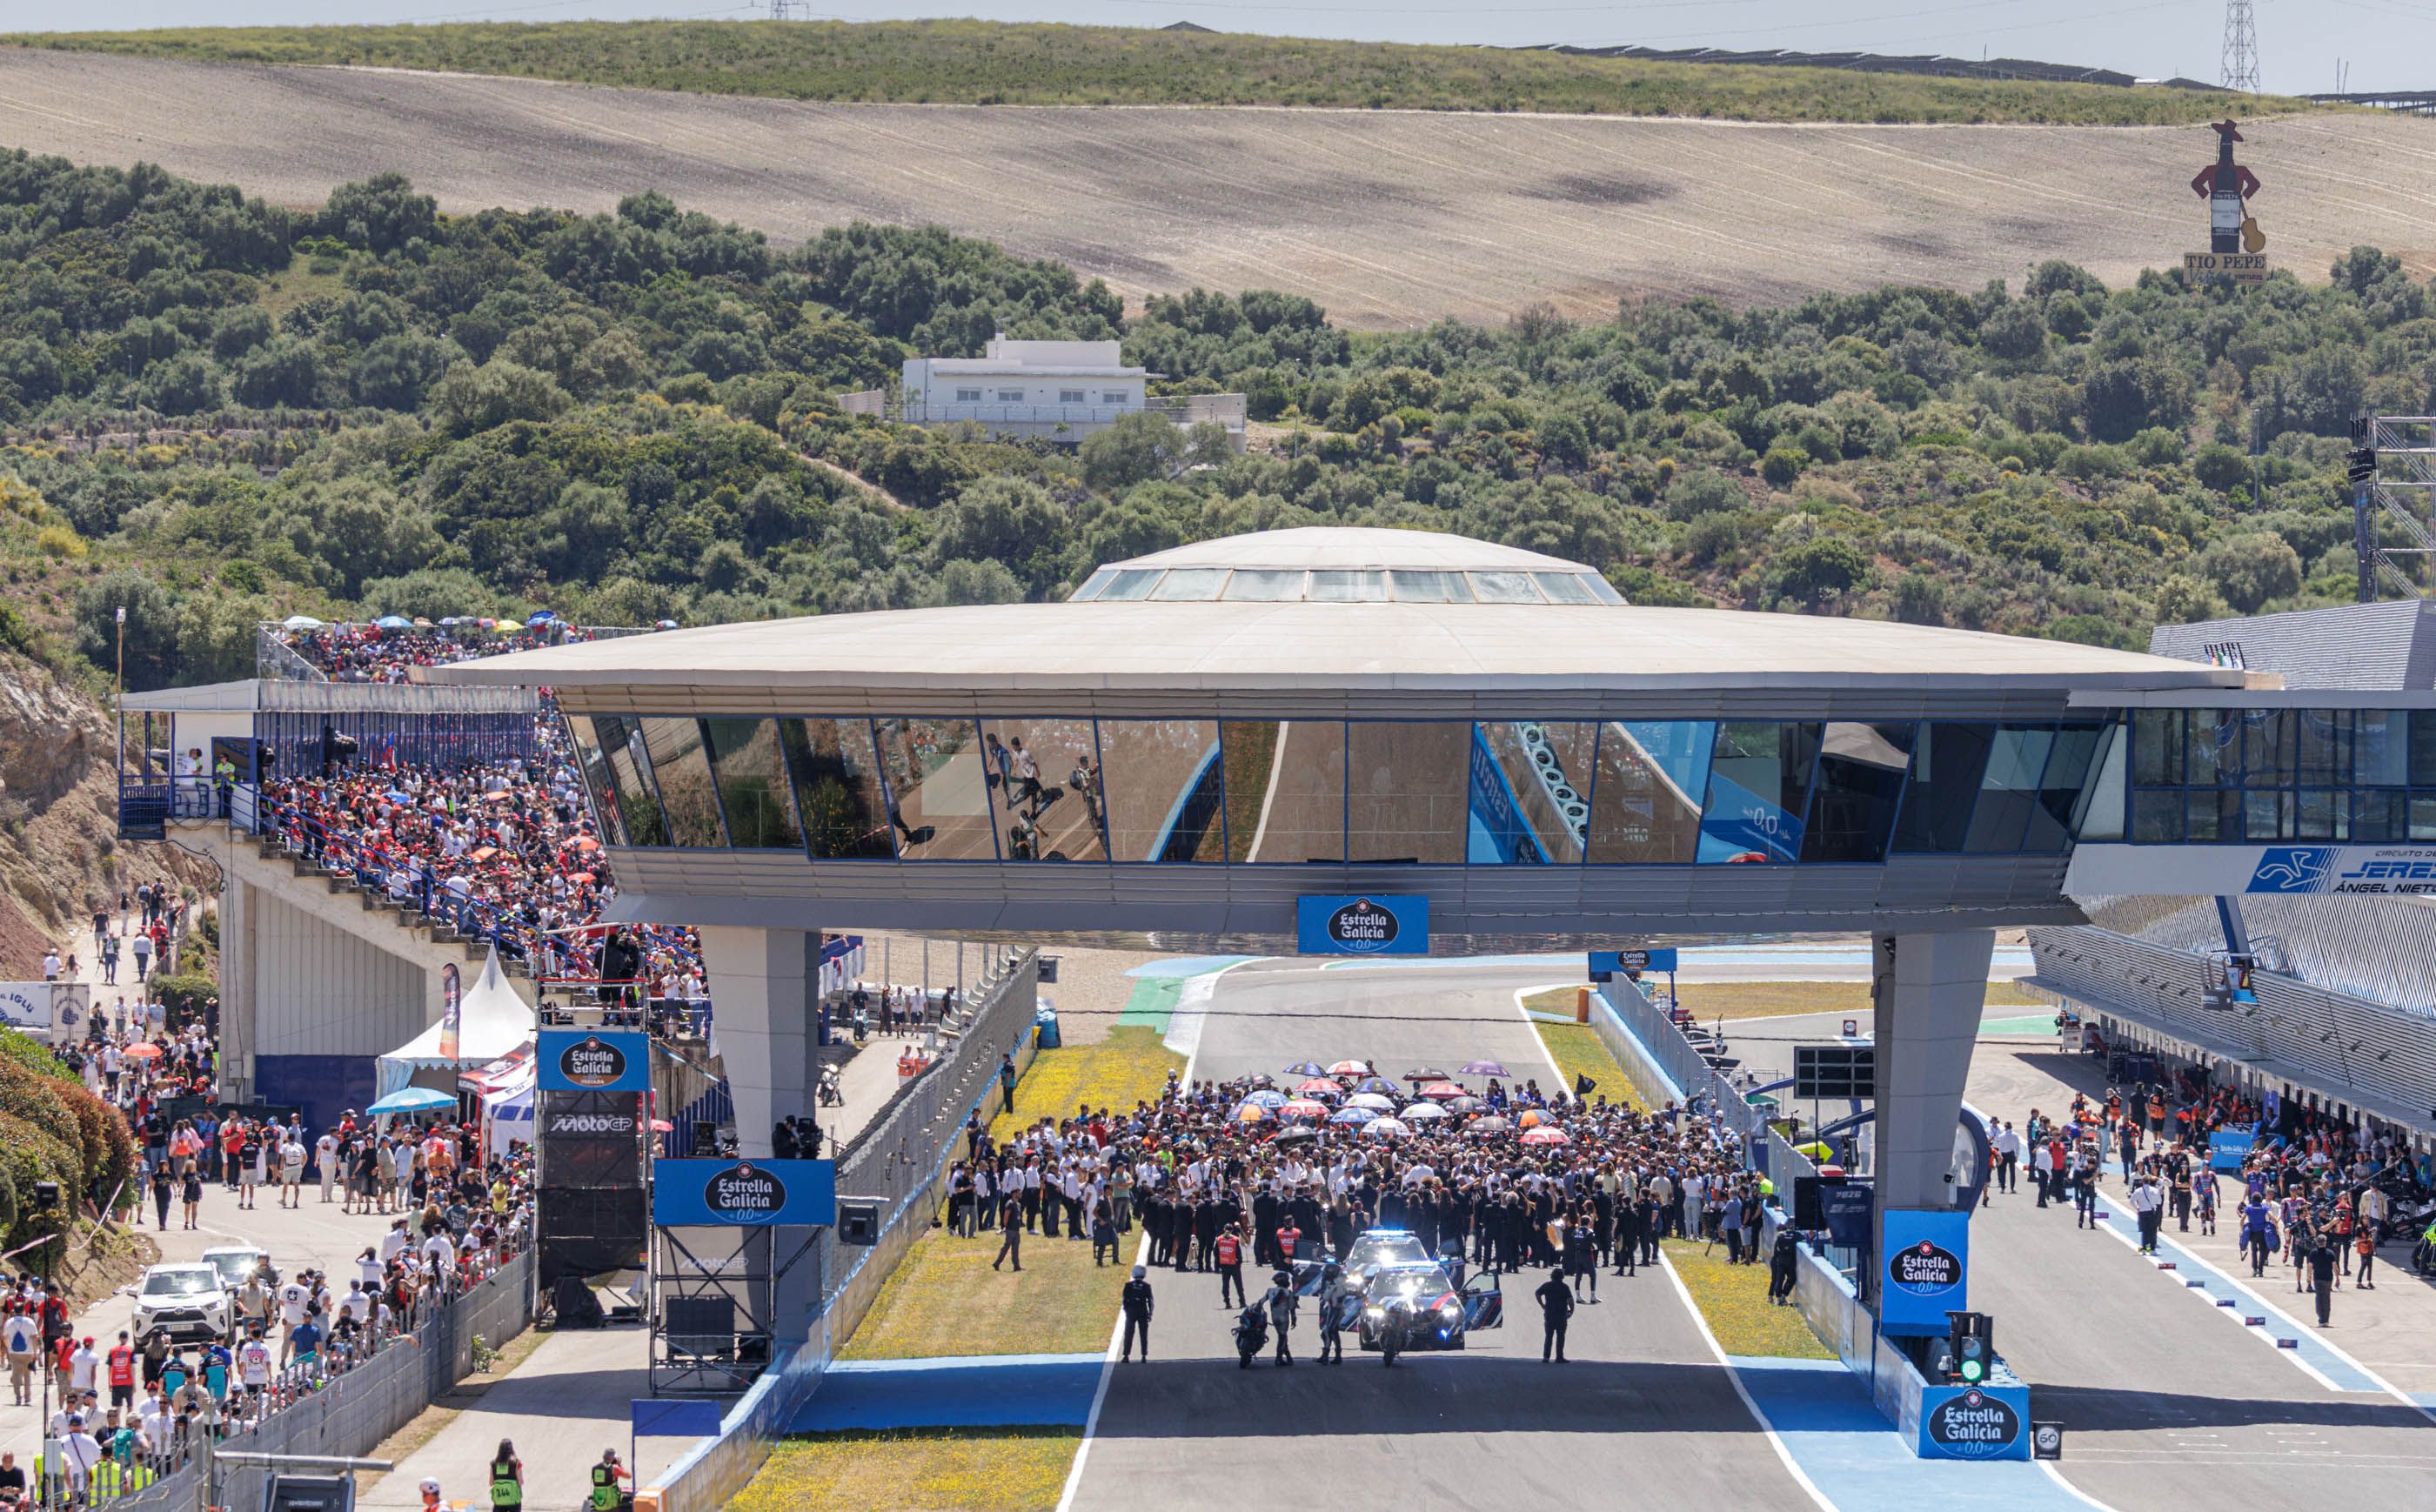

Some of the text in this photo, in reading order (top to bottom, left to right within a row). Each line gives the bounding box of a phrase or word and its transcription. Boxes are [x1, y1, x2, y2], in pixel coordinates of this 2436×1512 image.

[2186, 256, 2265, 269] TIO PEPE
[2333, 880, 2389, 893] ÁNGEL
[1339, 913, 1387, 926] Estrella
[1341, 926, 1384, 939] Galicia
[10, 993, 35, 1014] IGLU
[571, 1050, 613, 1062] Estrella
[572, 1061, 612, 1074] Galicia
[550, 1116, 632, 1132] MotoGP
[717, 1178, 773, 1194] Estrella
[719, 1193, 770, 1208] Galicia
[736, 1208, 754, 1221] 0,0
[1902, 1254, 1950, 1269] Estrella
[1903, 1268, 1948, 1282] Galicia
[1917, 1281, 1933, 1293] 0,0
[1943, 1406, 2004, 1423] Estrella
[1945, 1423, 2002, 1440] Galicia
[1964, 1441, 1984, 1455] 0,0
